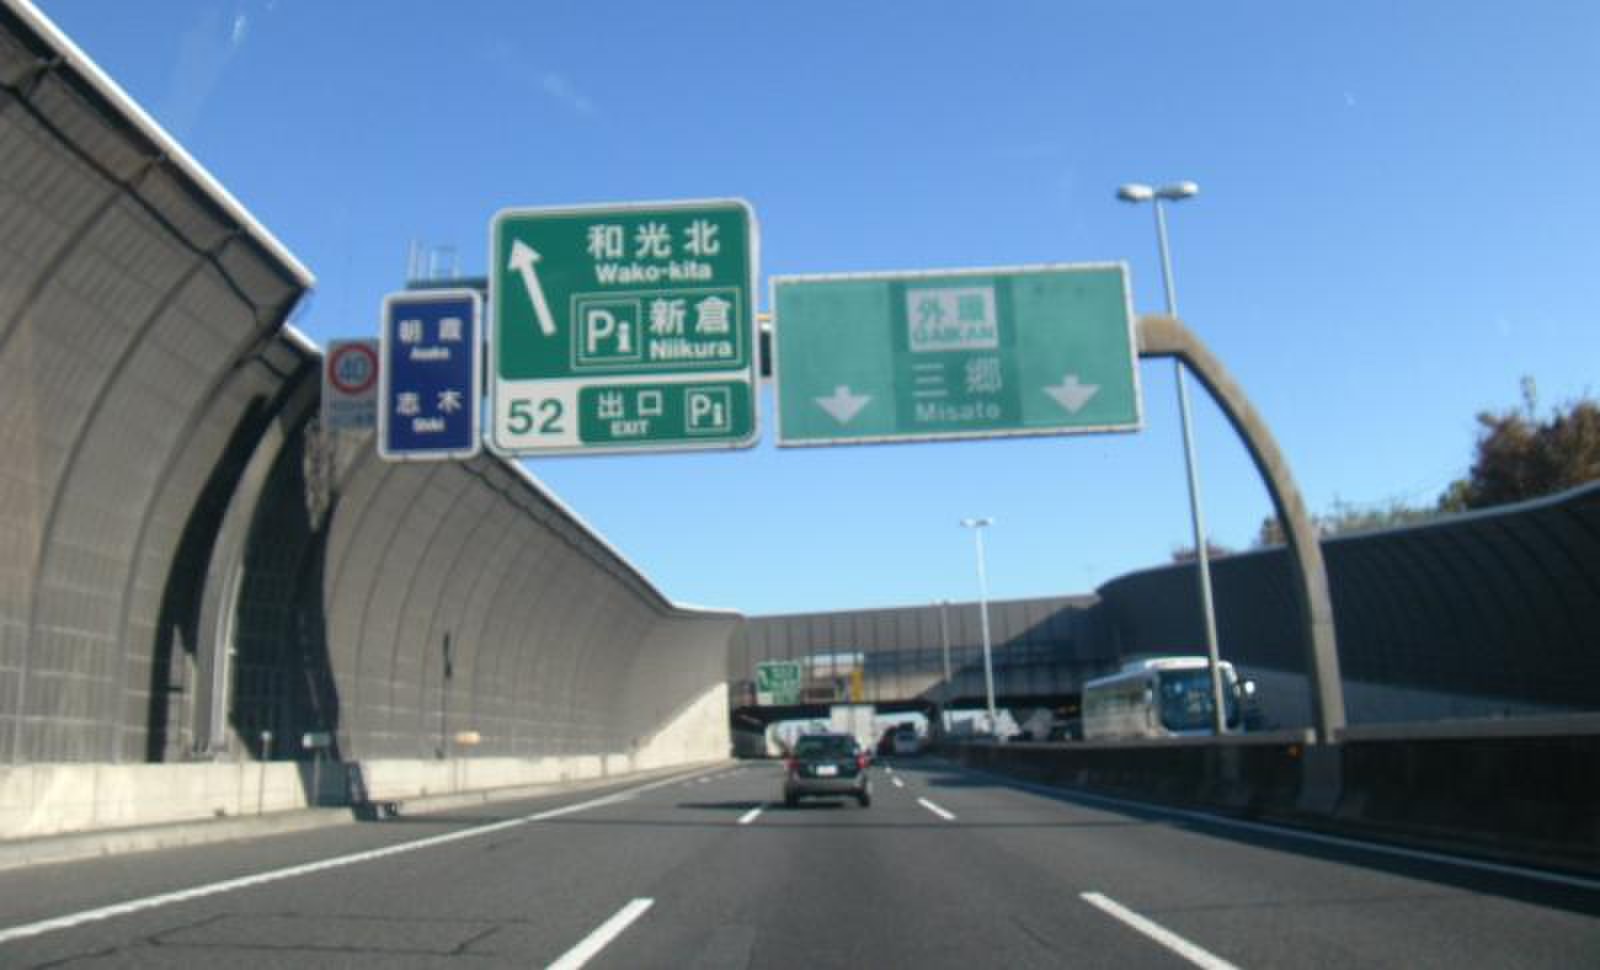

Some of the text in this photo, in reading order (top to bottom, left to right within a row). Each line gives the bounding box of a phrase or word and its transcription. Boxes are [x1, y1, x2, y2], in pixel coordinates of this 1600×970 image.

[586, 219, 720, 260] 和光北
[595, 261, 713, 284] Wako-kita
[649, 296, 732, 336] 新倉
[649, 339, 733, 360] Niikura
[507, 397, 565, 435] 52
[598, 390, 663, 418] 出口
[914, 401, 1002, 421] Misato
[611, 420, 650, 437] EXIT
